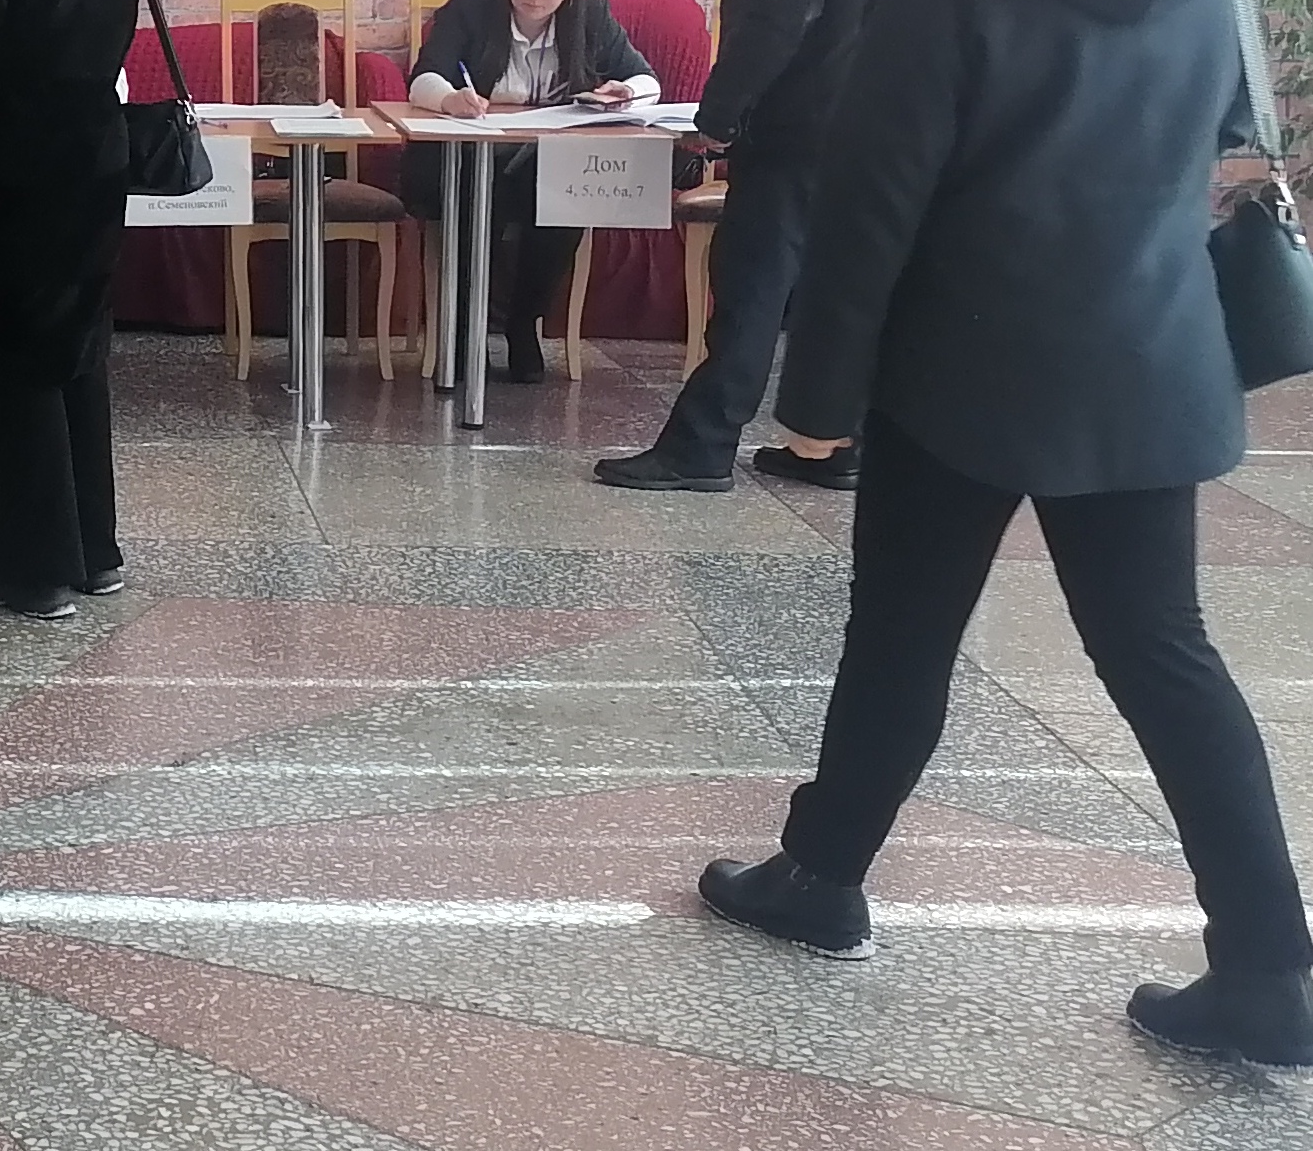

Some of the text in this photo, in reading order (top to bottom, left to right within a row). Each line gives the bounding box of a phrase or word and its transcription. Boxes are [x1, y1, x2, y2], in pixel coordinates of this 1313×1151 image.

[582, 154, 628, 175] Дом
[565, 184, 578, 198] 4,
[581, 184, 594, 198] 5,
[597, 185, 610, 198] 6,
[636, 185, 645, 197] 7
